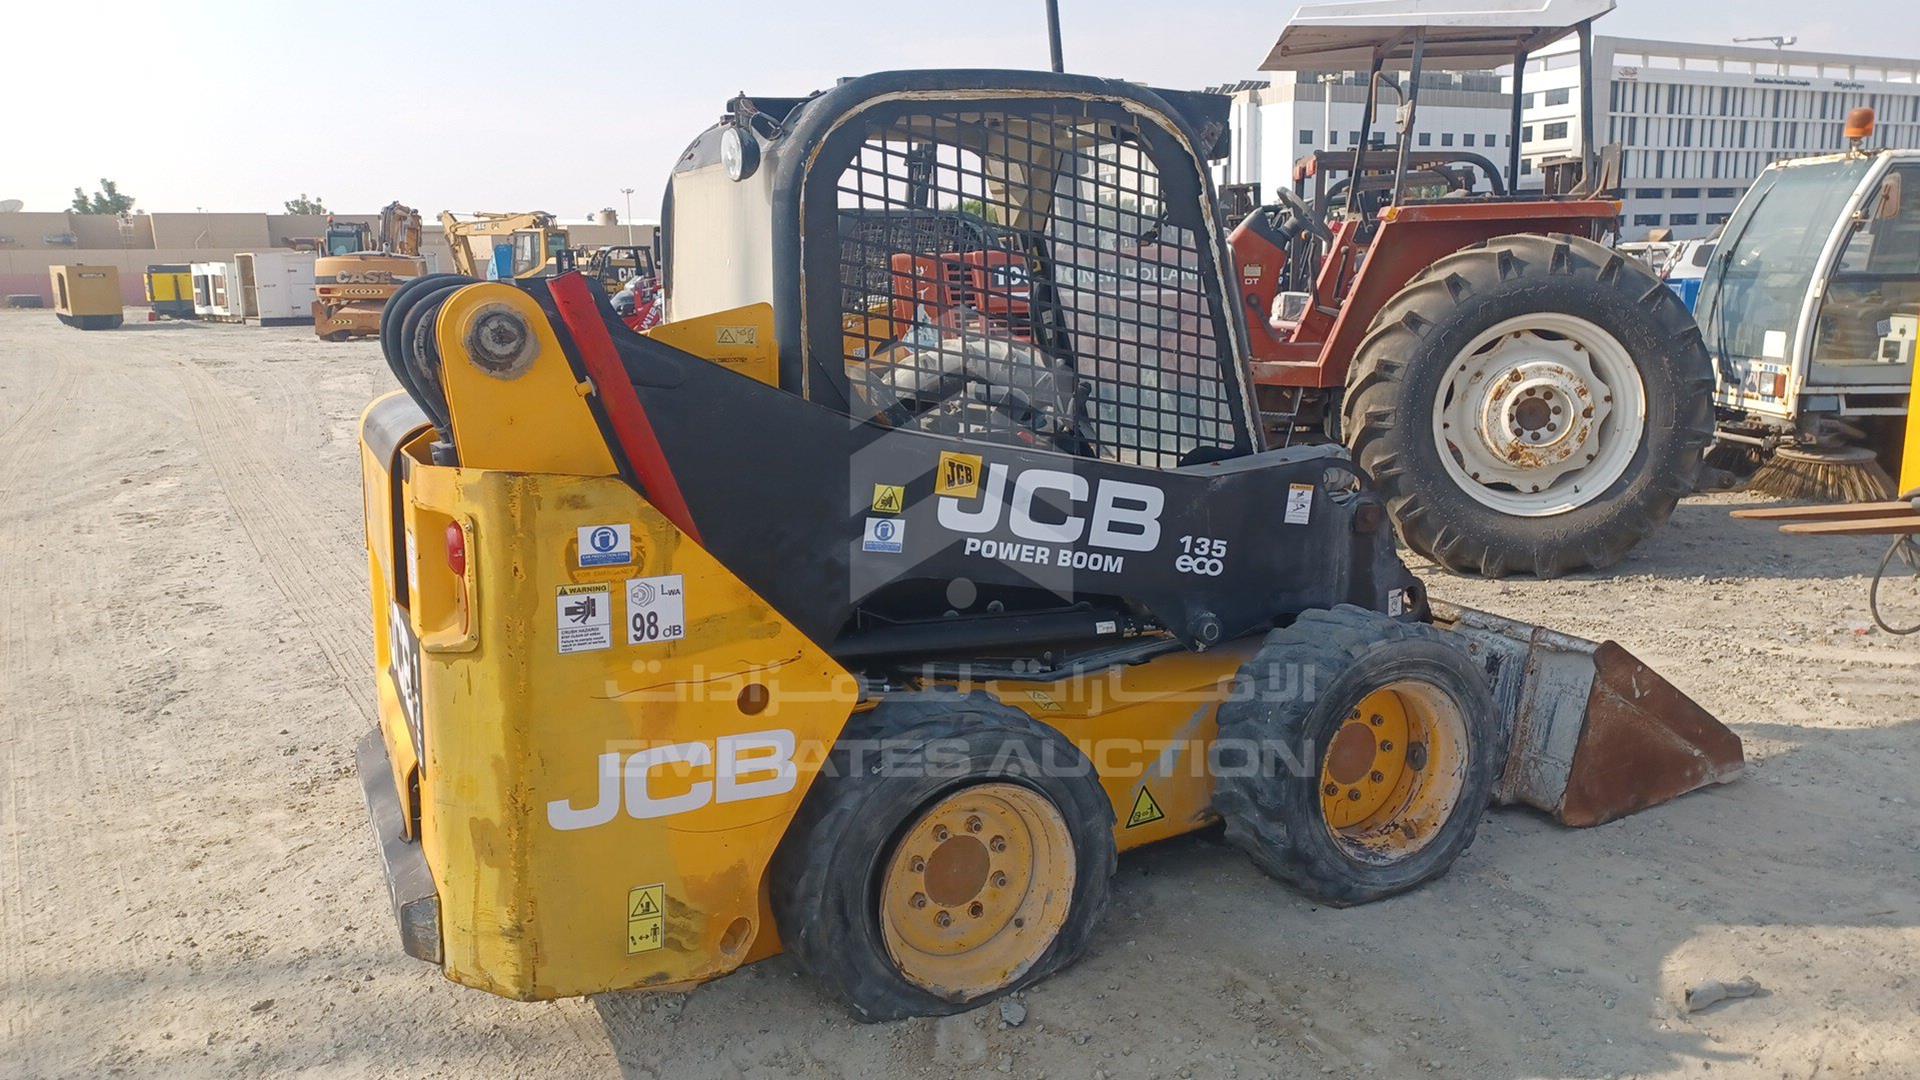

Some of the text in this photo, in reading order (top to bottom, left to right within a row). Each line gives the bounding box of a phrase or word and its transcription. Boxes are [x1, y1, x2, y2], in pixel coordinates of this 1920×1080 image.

[618, 267, 637, 282] CAT
[946, 460, 973, 488] JCB
[937, 462, 1165, 552] JCB
[964, 537, 1124, 574] POWER BOOM
[1179, 535, 1228, 558] 135
[1175, 555, 1223, 577] eco
[569, 585, 607, 593] WARNING
[632, 611, 682, 642] 98 dB
[547, 729, 798, 831] JCB
